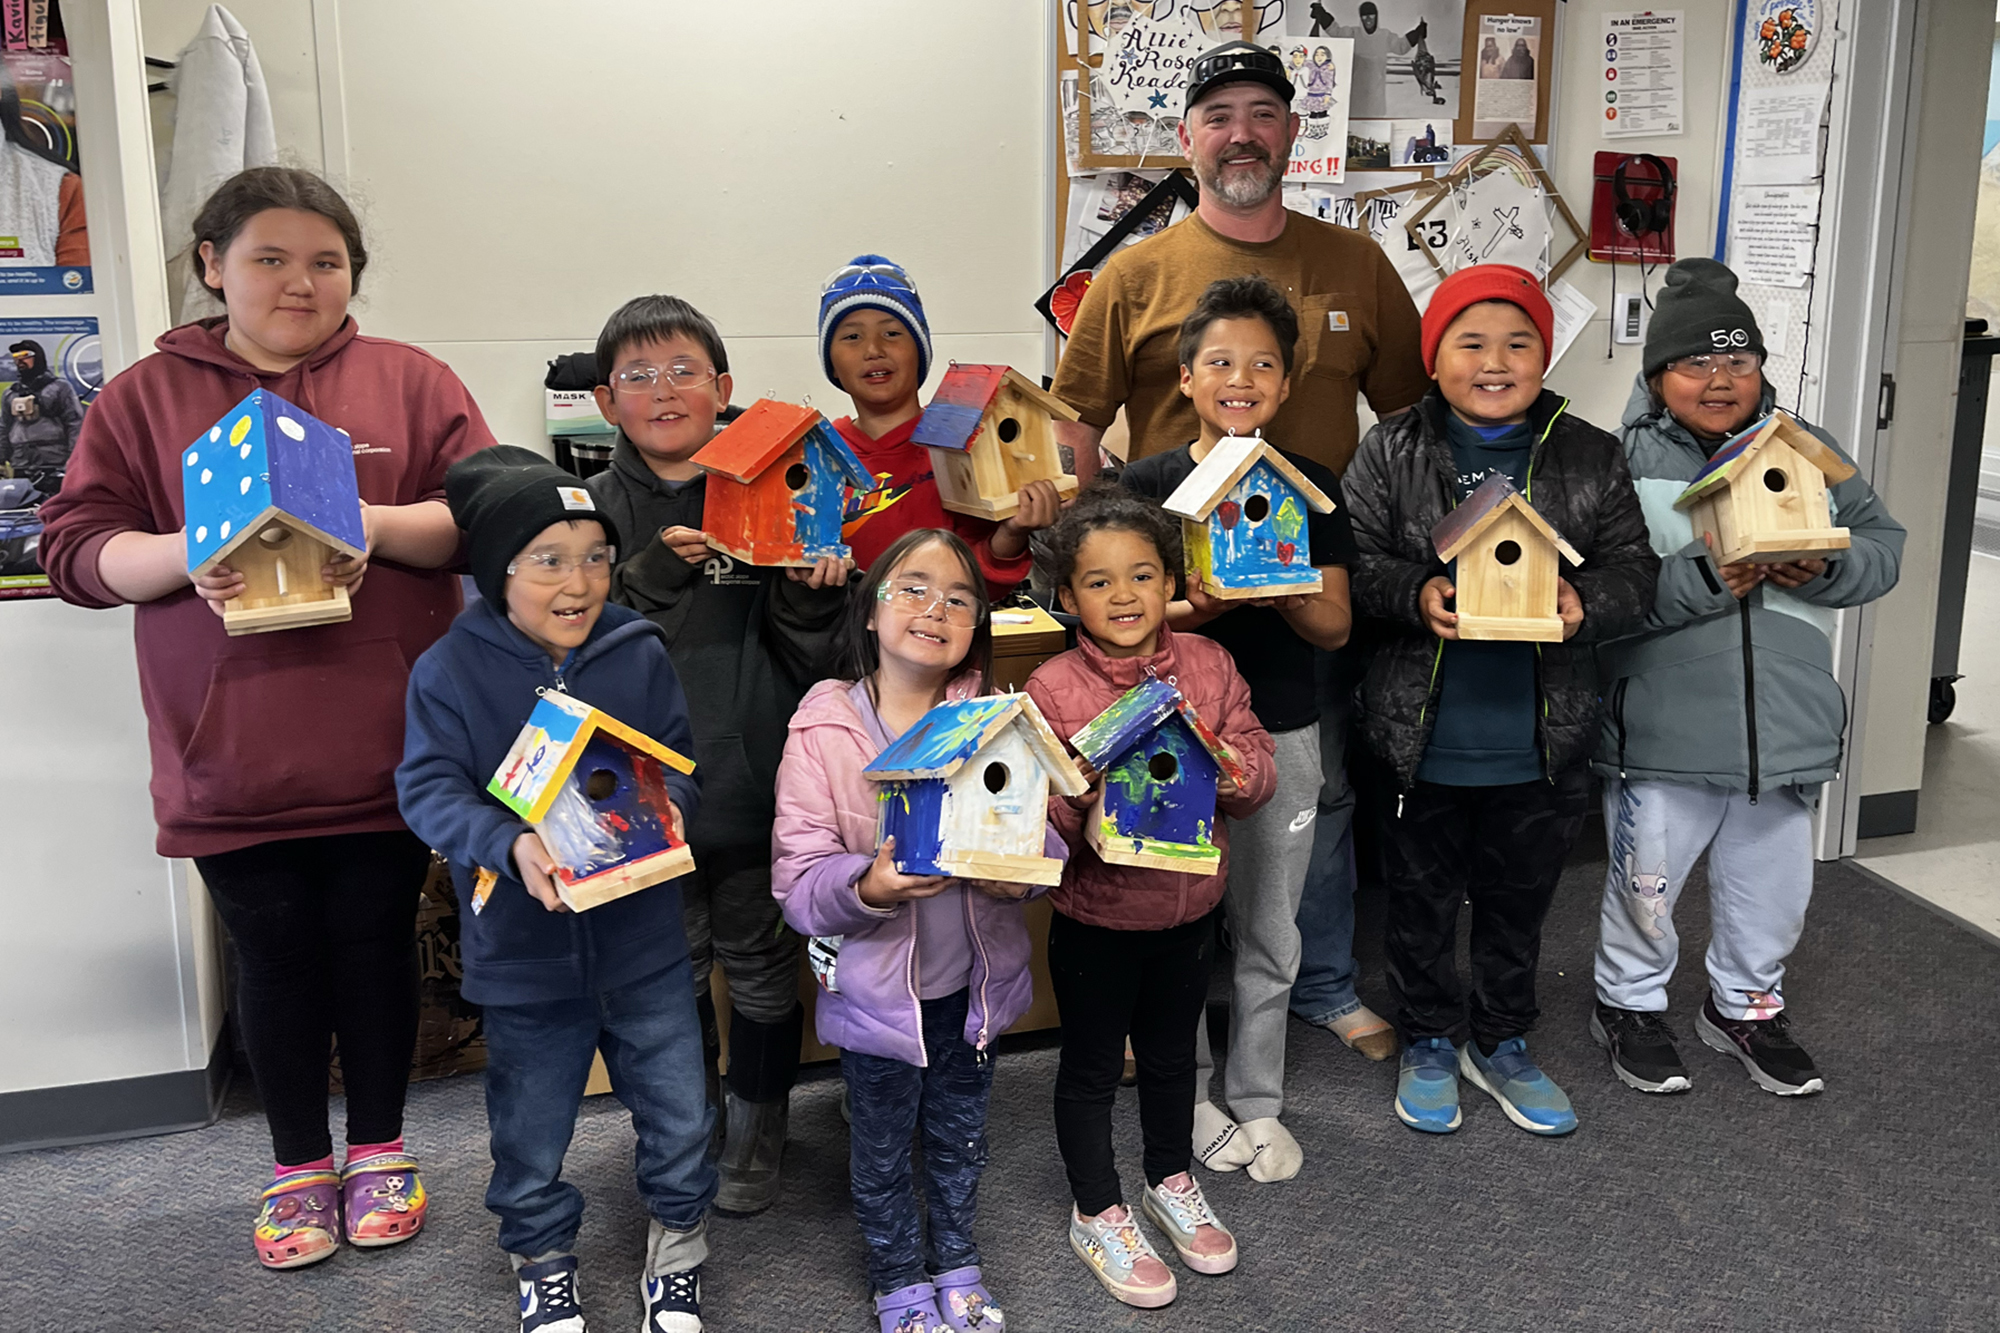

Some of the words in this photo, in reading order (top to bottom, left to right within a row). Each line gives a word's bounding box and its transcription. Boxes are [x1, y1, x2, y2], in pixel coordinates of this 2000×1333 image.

[7, 0, 25, 43] Kavi
[1632, 17, 1676, 25] EMERGENCY
[1121, 27, 1188, 51] Allie
[1136, 50, 1195, 71] Rose
[1201, 1122, 1234, 1158] JORDAN
